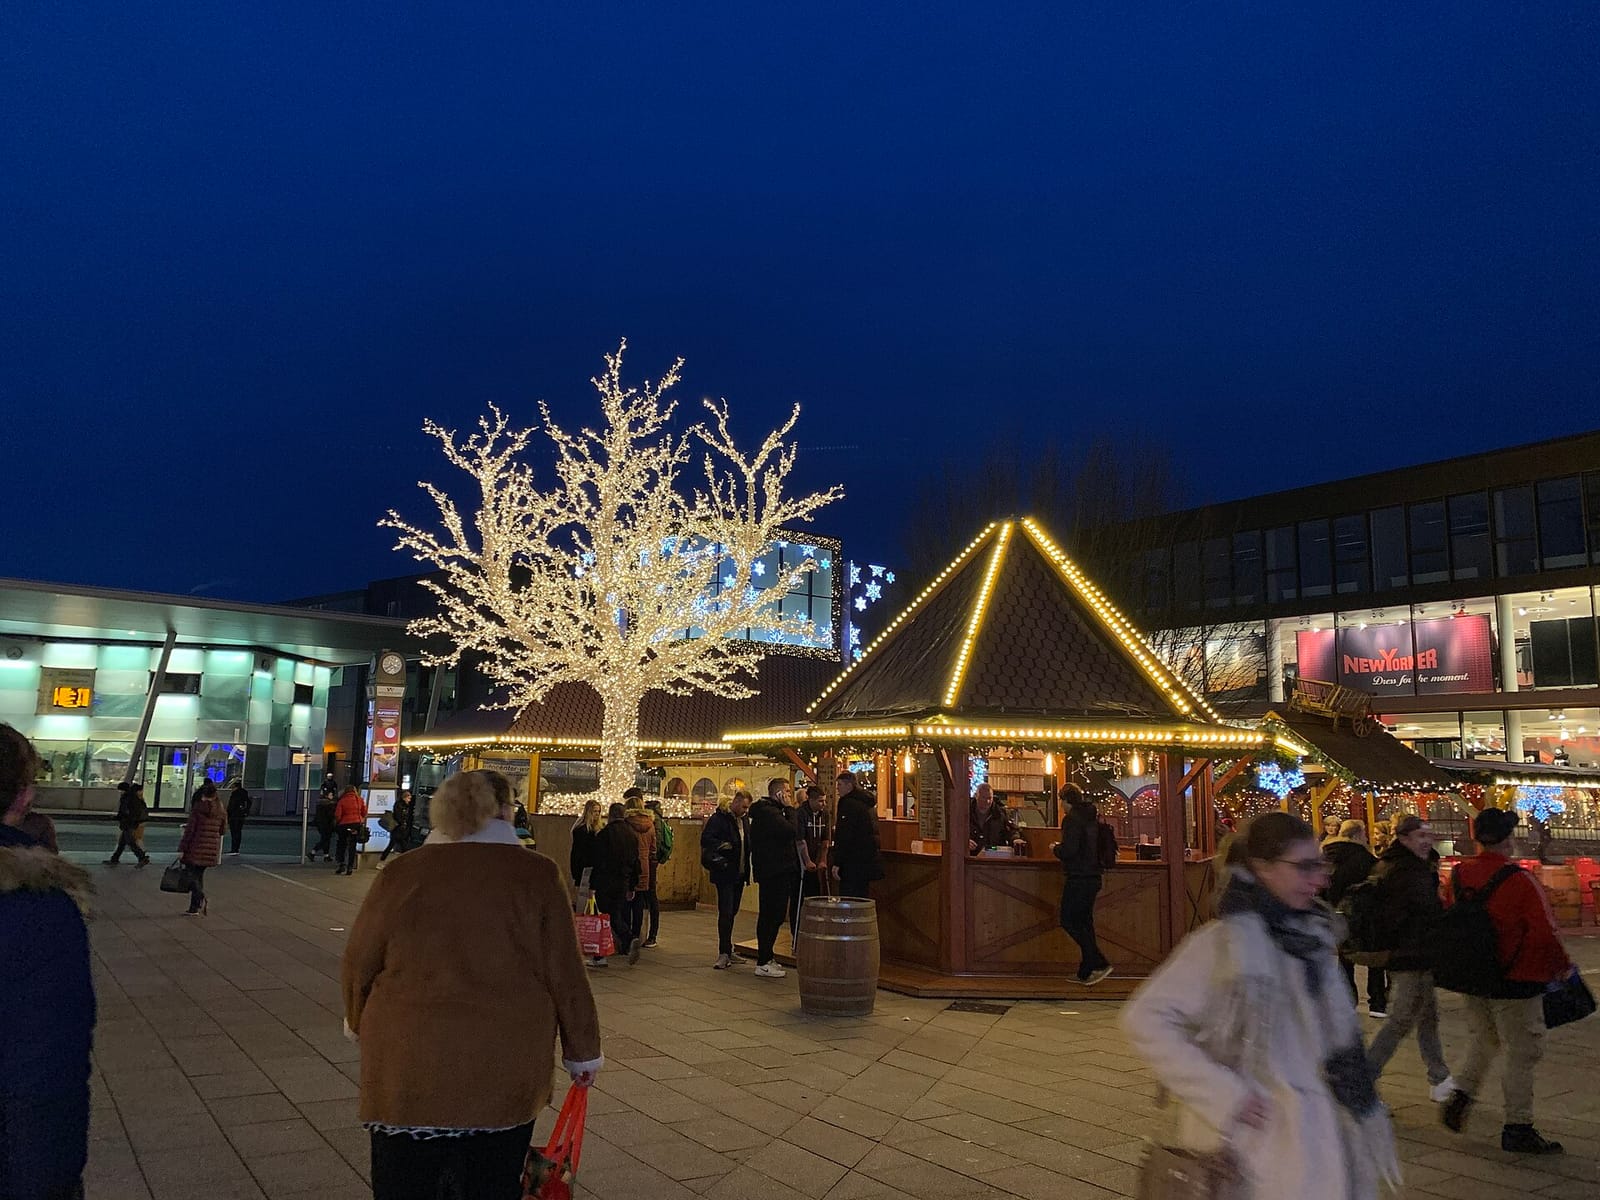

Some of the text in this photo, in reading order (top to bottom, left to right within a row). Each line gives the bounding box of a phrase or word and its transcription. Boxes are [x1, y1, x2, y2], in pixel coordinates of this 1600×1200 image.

[1372, 672, 1470, 687] Dress for he moment.
